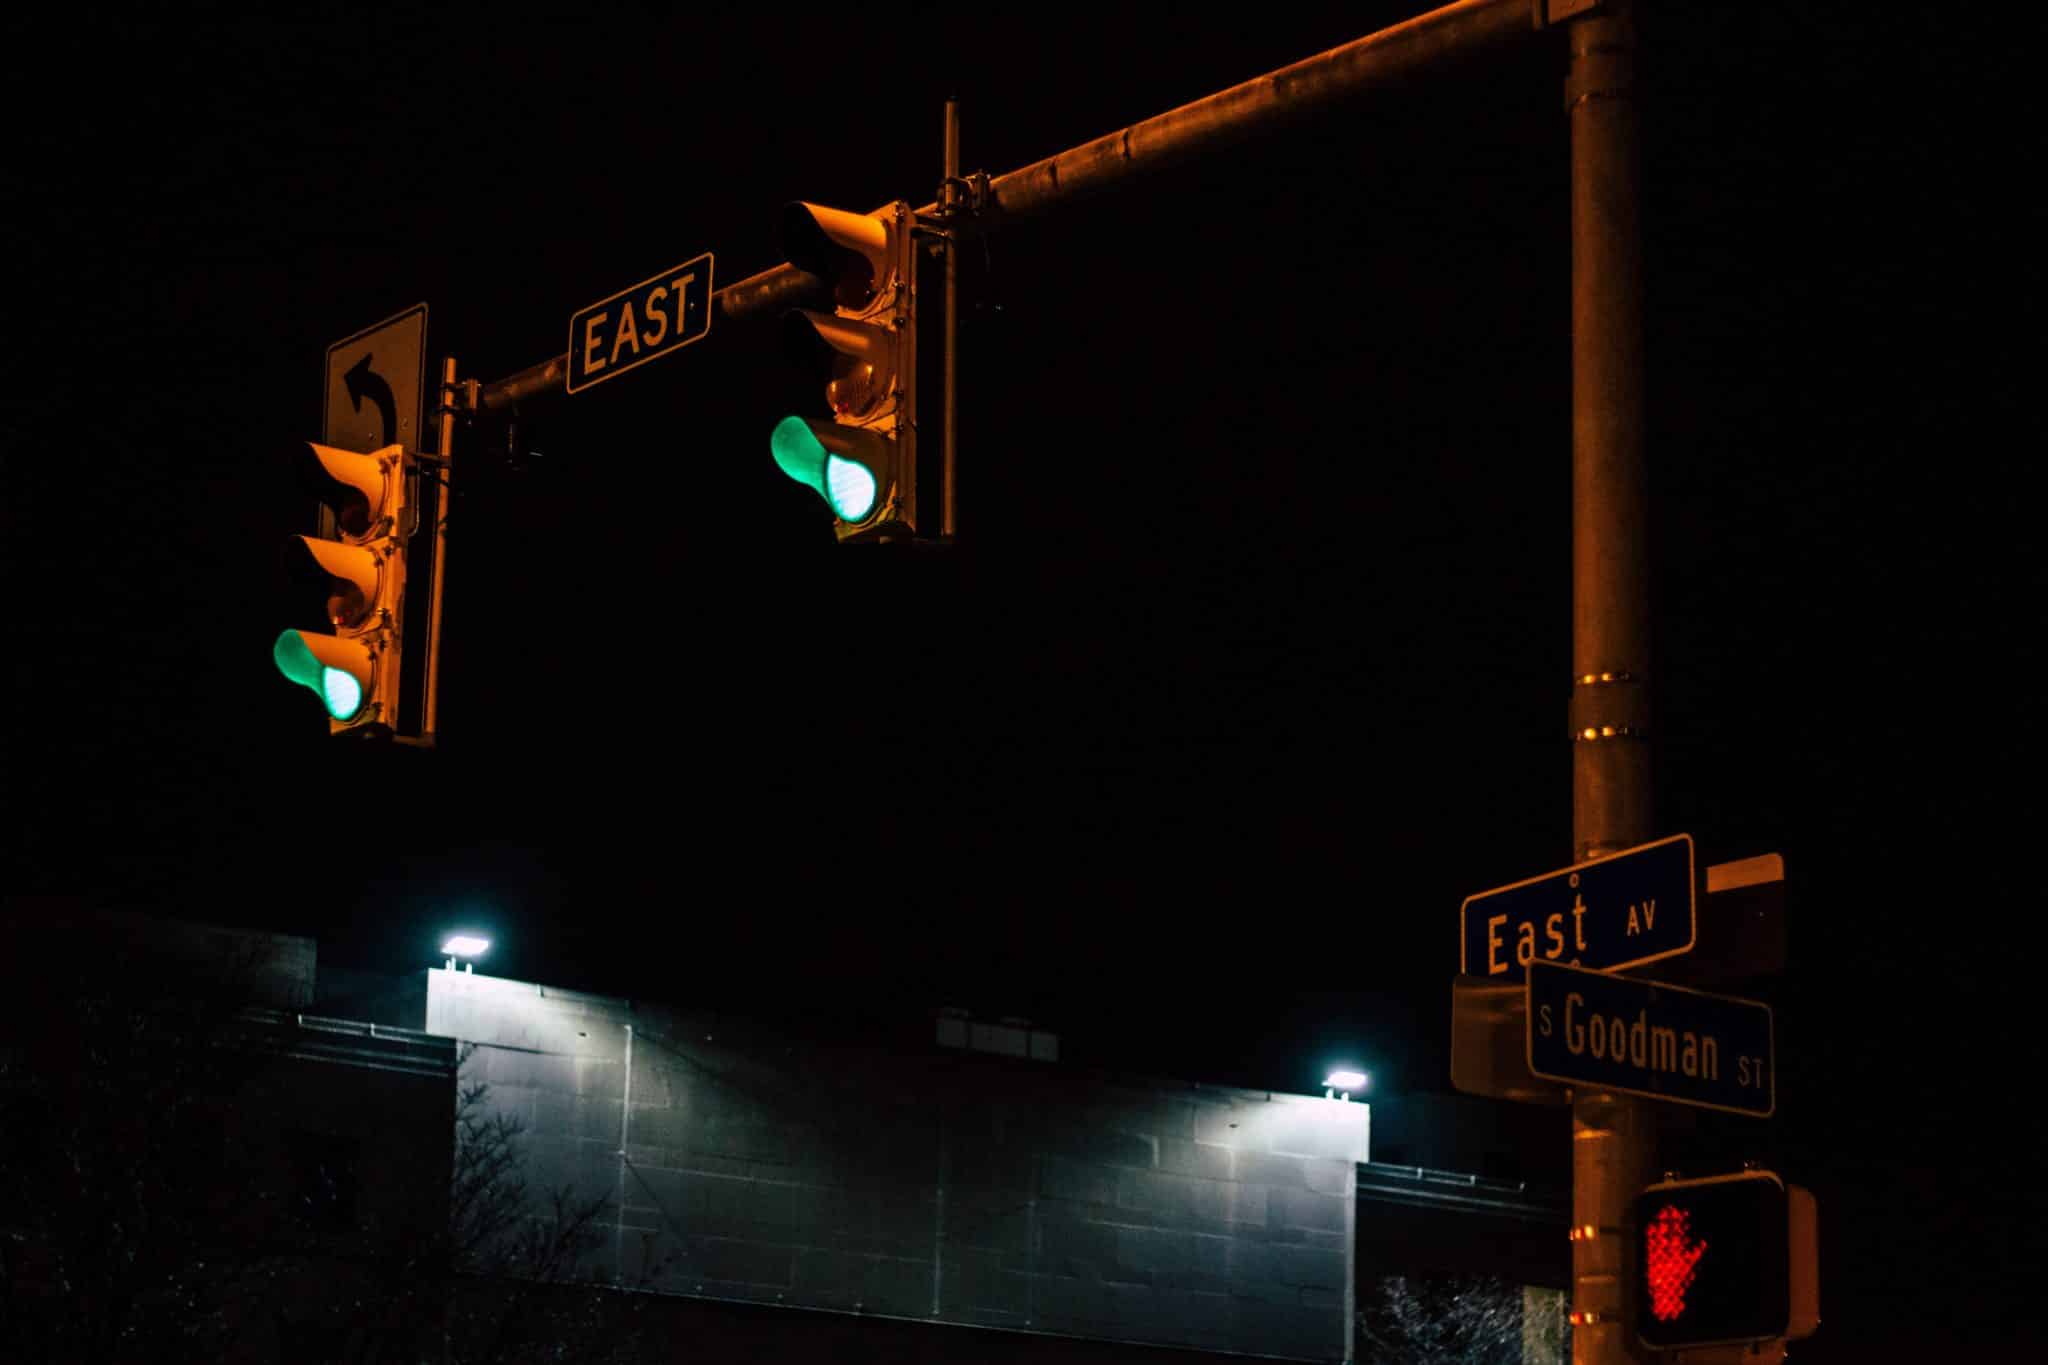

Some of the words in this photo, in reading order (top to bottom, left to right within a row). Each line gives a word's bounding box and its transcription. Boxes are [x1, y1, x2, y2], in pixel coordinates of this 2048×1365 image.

[583, 271, 696, 376] EAST
[1487, 893, 1588, 976] East
[1625, 898, 1657, 936] AV
[1538, 1003, 1553, 1039] S
[1563, 991, 1719, 1081] Goodman
[1736, 1056, 1765, 1089] ST
